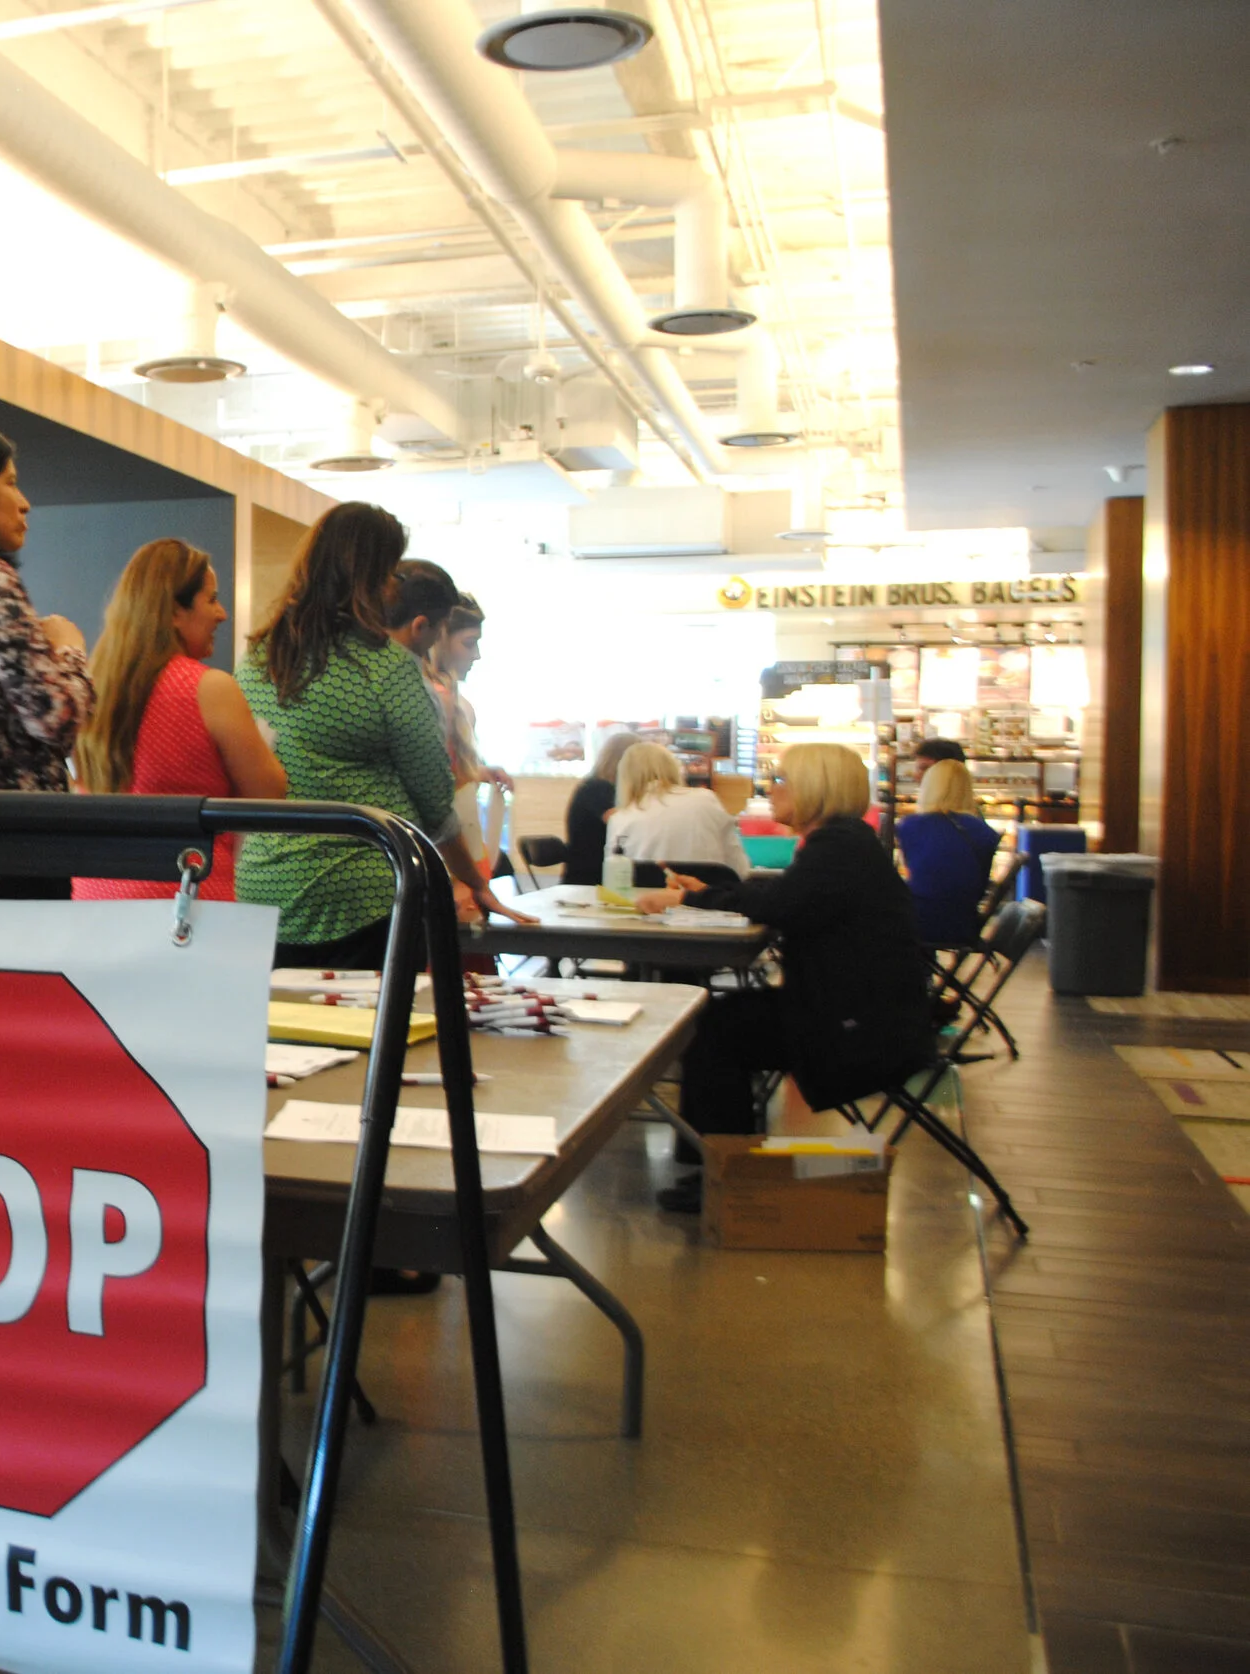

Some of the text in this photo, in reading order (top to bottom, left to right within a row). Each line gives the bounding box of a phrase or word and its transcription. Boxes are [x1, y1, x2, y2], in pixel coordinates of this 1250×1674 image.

[756, 584, 875, 609] EINSTEIN
[970, 574, 1076, 604] BAGELS
[6, 1544, 191, 1652] Form
